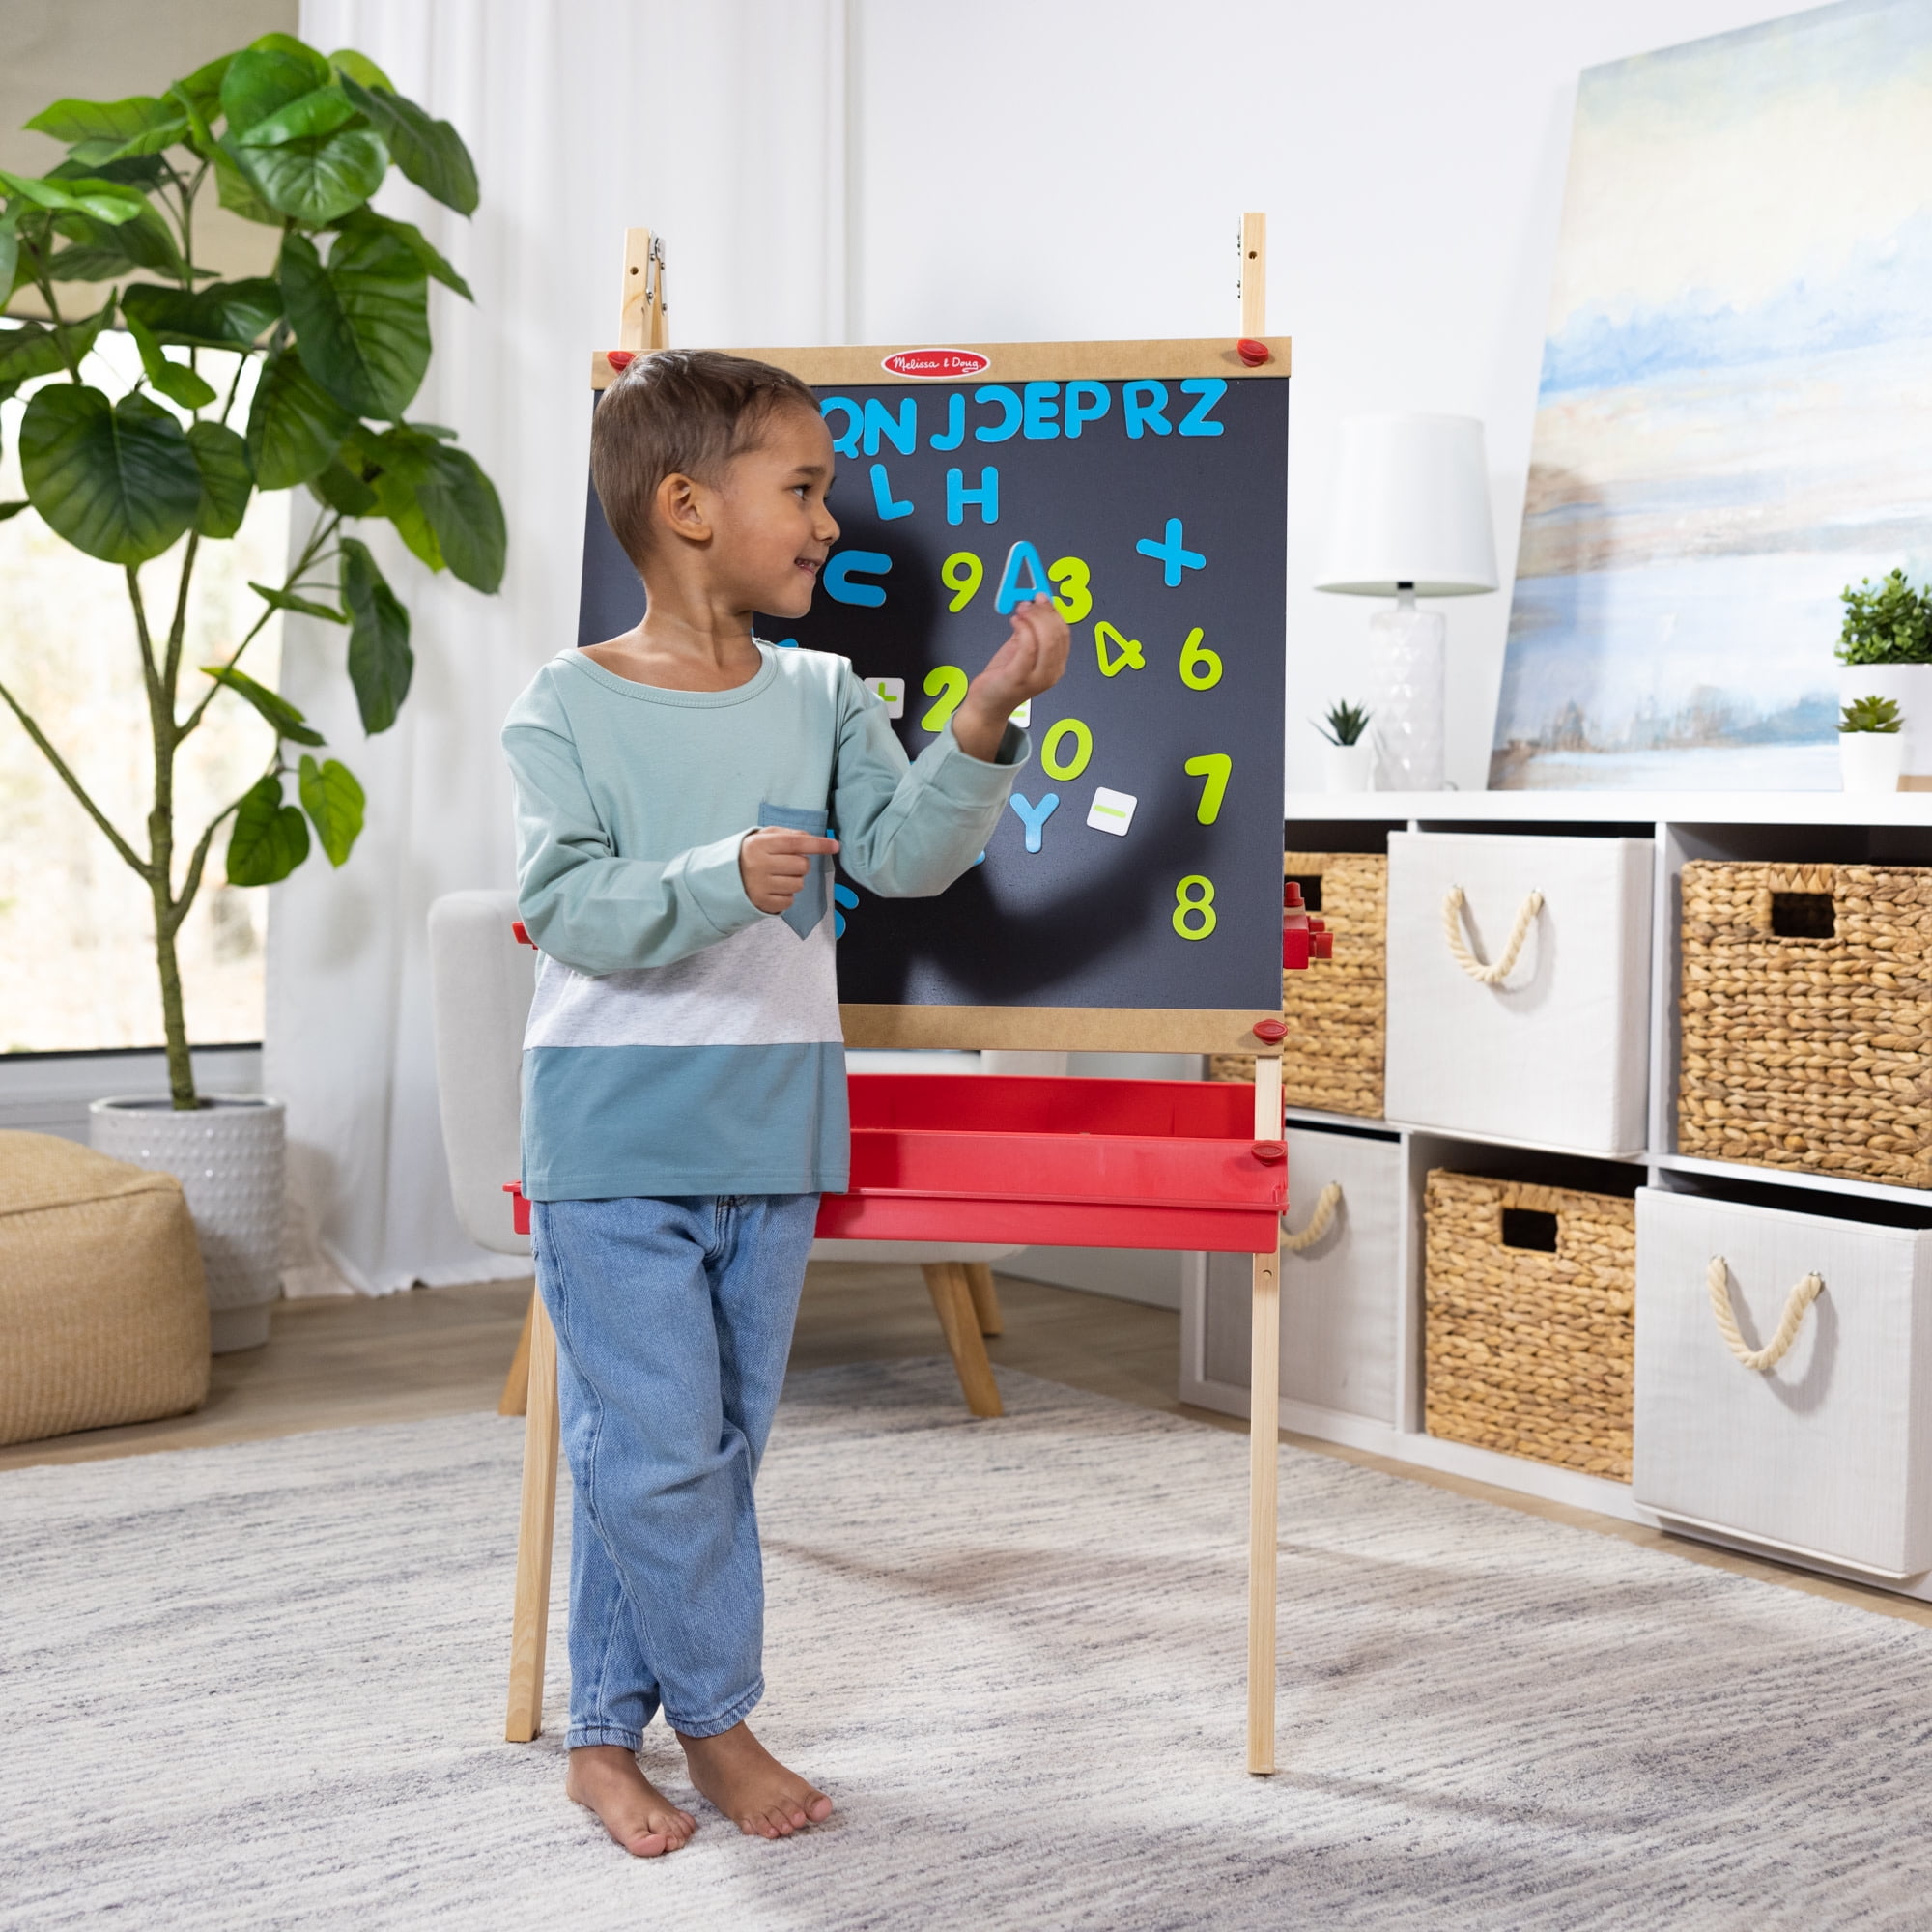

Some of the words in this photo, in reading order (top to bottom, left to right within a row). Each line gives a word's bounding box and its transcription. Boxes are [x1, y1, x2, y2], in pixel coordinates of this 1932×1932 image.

[893, 356, 940, 371] Melissa
[869, 463, 915, 521] L
[946, 466, 999, 526] H
[941, 551, 983, 613] 9
[994, 540, 1055, 615] A
[1048, 556, 1094, 624] 3
[1094, 620, 1146, 678] 4
[1179, 626, 1223, 691] 6
[921, 665, 969, 733] 2
[1184, 753, 1233, 825] 7
[1009, 792, 1060, 854] Y
[1172, 874, 1217, 941] 8
